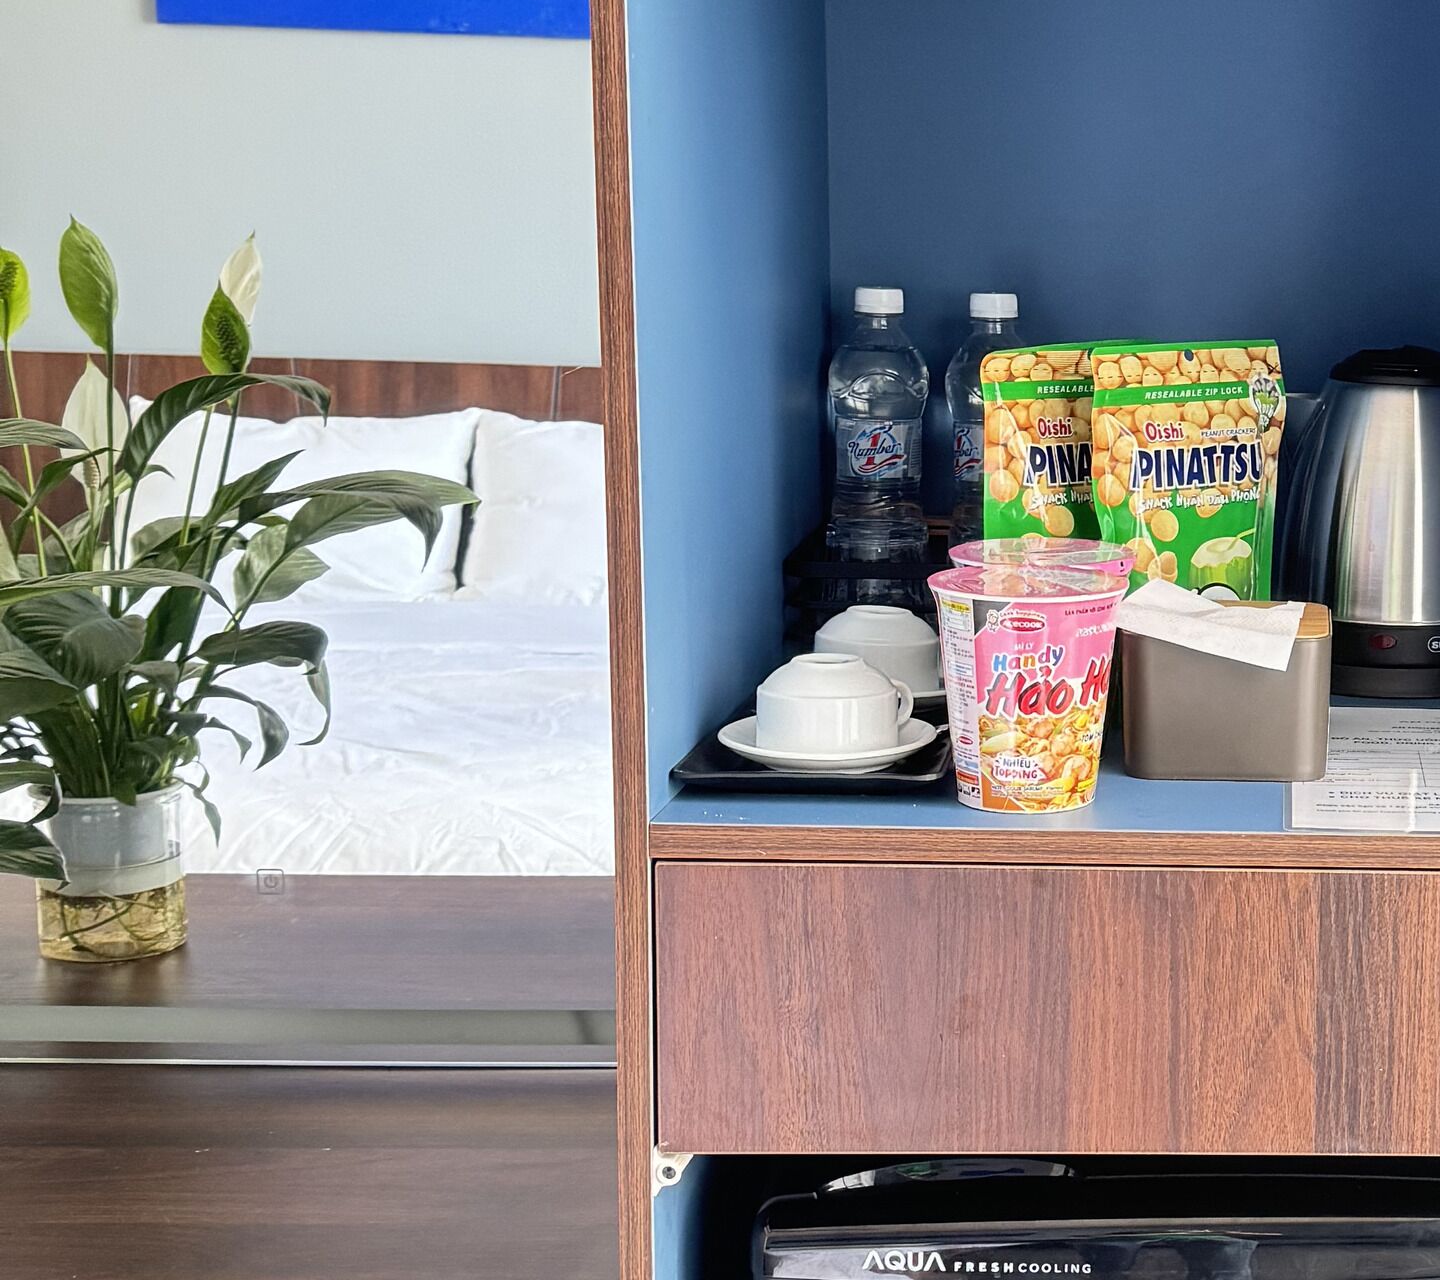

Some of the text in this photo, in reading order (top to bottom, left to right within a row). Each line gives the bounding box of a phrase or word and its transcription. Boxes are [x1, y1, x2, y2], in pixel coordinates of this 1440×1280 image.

[1145, 386, 1243, 400] RESEALABLE ZIP LOCK
[1037, 417, 1073, 437] Oishi
[1144, 422, 1184, 442] Oishi
[848, 438, 901, 460] Number
[1024, 442, 1093, 486] PINA
[1131, 442, 1263, 490] PINATTSU
[992, 645, 1064, 672] Handy
[862, 1250, 947, 1272] AQUA
